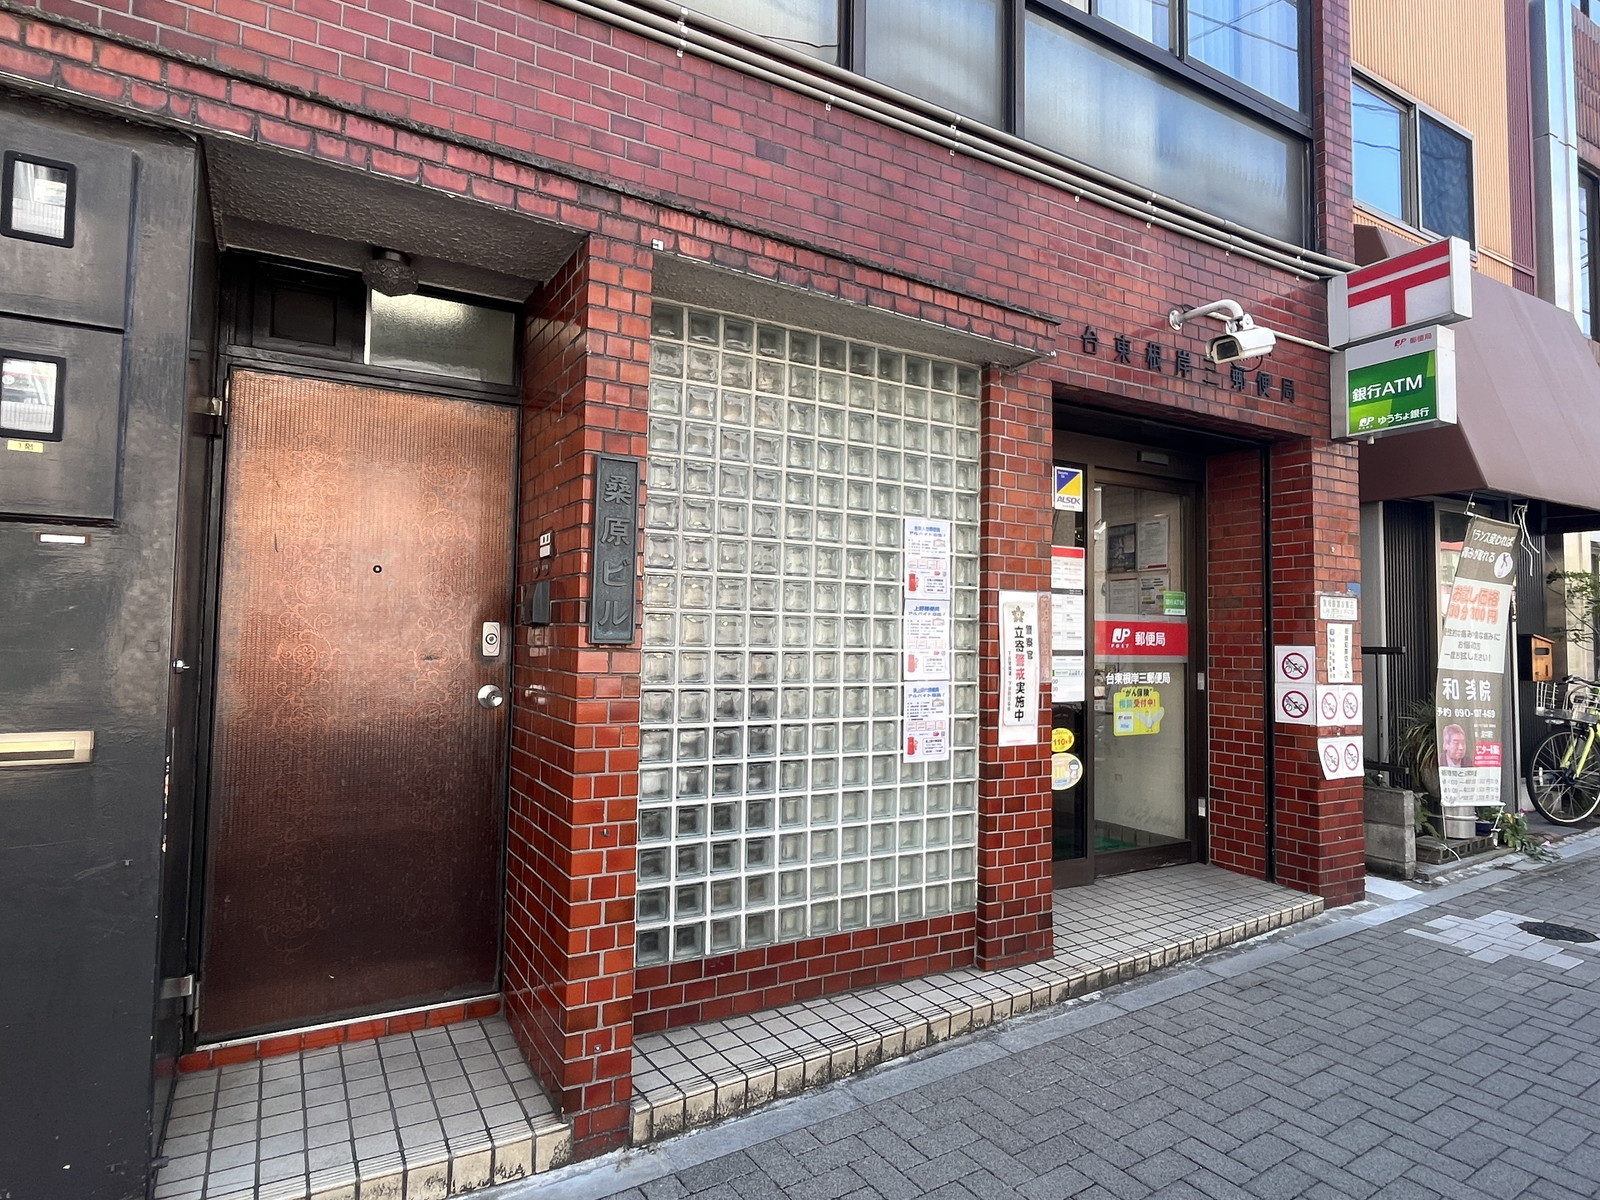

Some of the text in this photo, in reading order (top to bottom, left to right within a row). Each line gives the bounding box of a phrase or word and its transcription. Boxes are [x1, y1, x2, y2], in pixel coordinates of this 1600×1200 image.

[1409, 332, 1432, 344] 郵便局
[1081, 326, 1295, 404] 台東根岸三郵便局
[1351, 374, 1423, 403] 銀行ATM
[1377, 407, 1430, 425] ゆうちょ銀行
[598, 475, 633, 627] 桑原ビル
[1025, 624, 1034, 660] 警察官
[1135, 631, 1166, 647] 郵便局
[1013, 625, 1026, 722] 立寄警戒実施中
[1105, 672, 1171, 685] 台東根岸三郵便局
